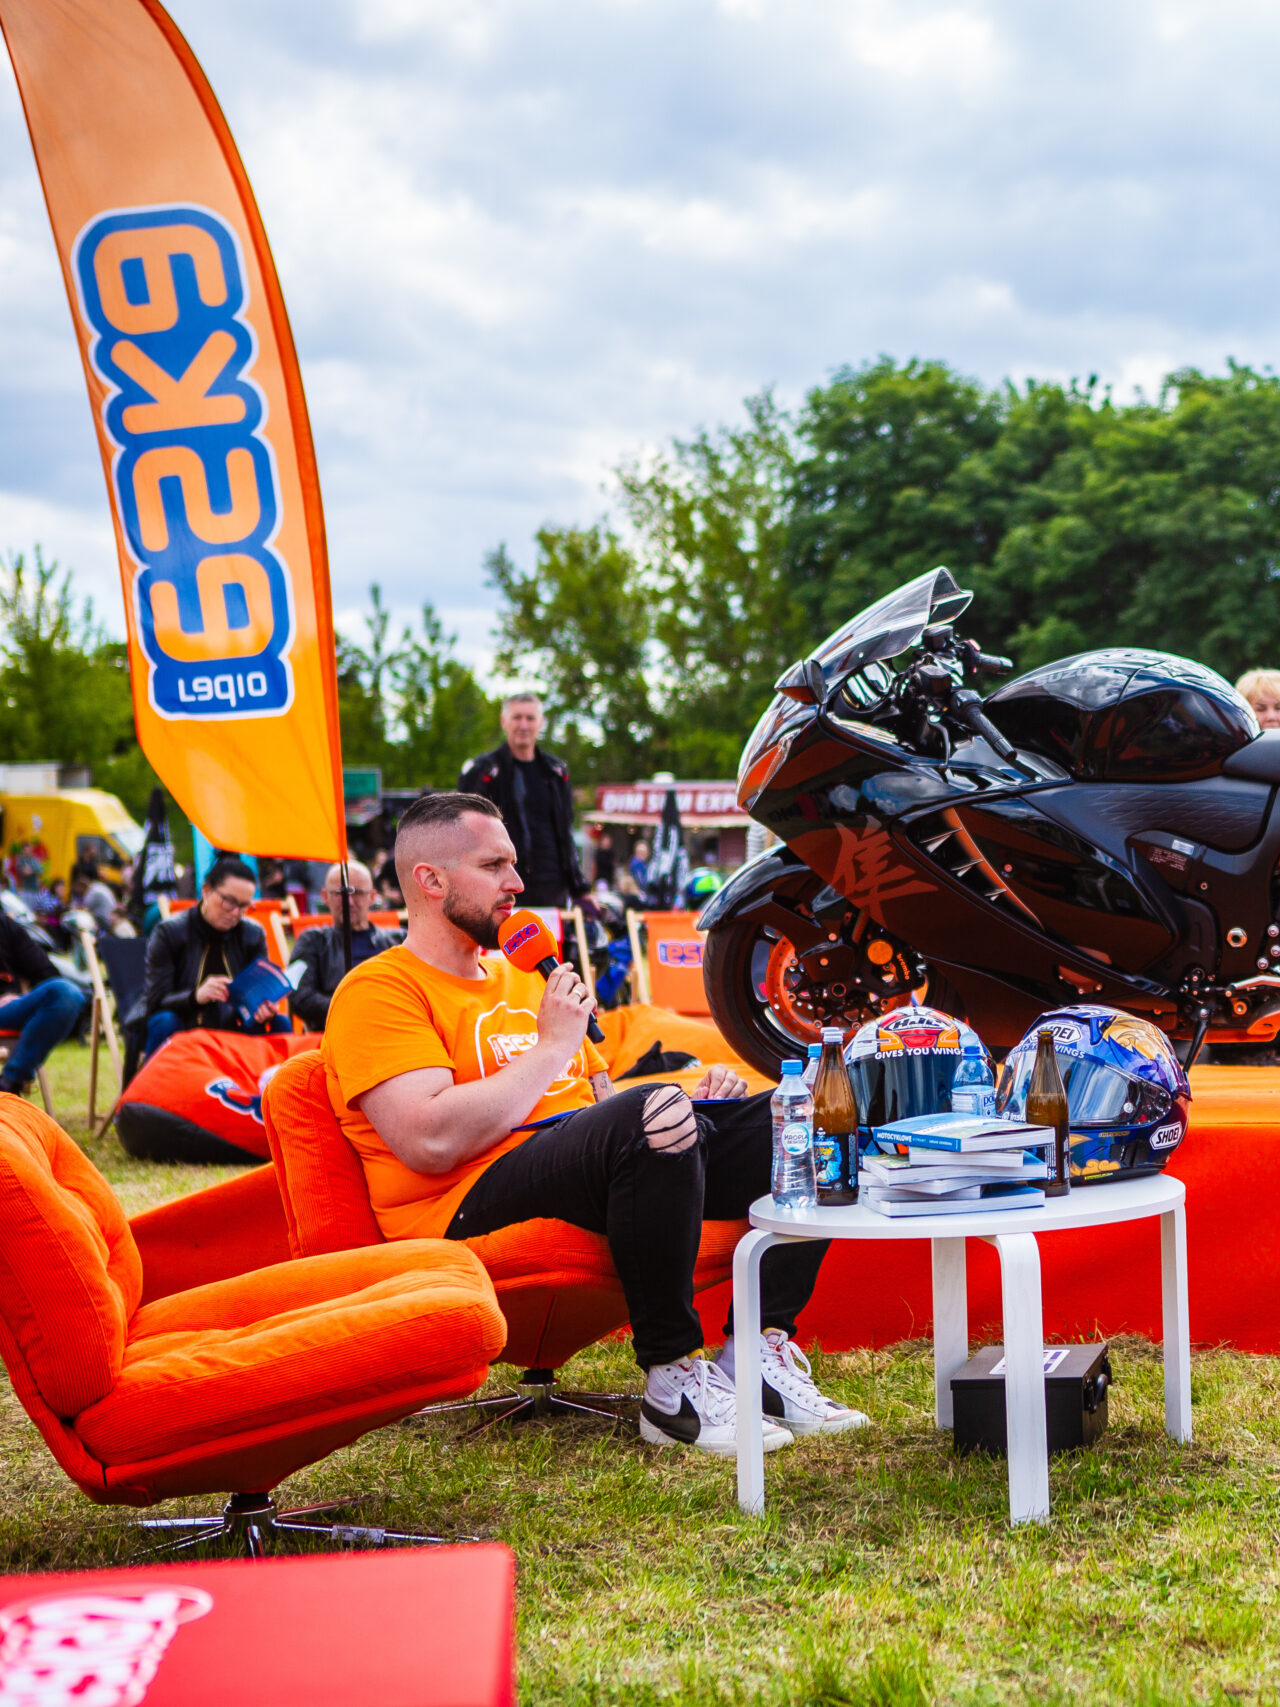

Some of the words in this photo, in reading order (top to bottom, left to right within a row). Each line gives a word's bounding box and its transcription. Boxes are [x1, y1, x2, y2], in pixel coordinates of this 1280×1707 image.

[1034, 667, 1088, 687] SUZU
[647, 791, 692, 812] SM
[506, 923, 539, 952] eska
[874, 1049, 904, 1060] GIVES
[906, 1048, 930, 1056] YOU
[876, 1132, 912, 1143] MOTOCYKLOWE
[1155, 1126, 1180, 1145] SHOEI
